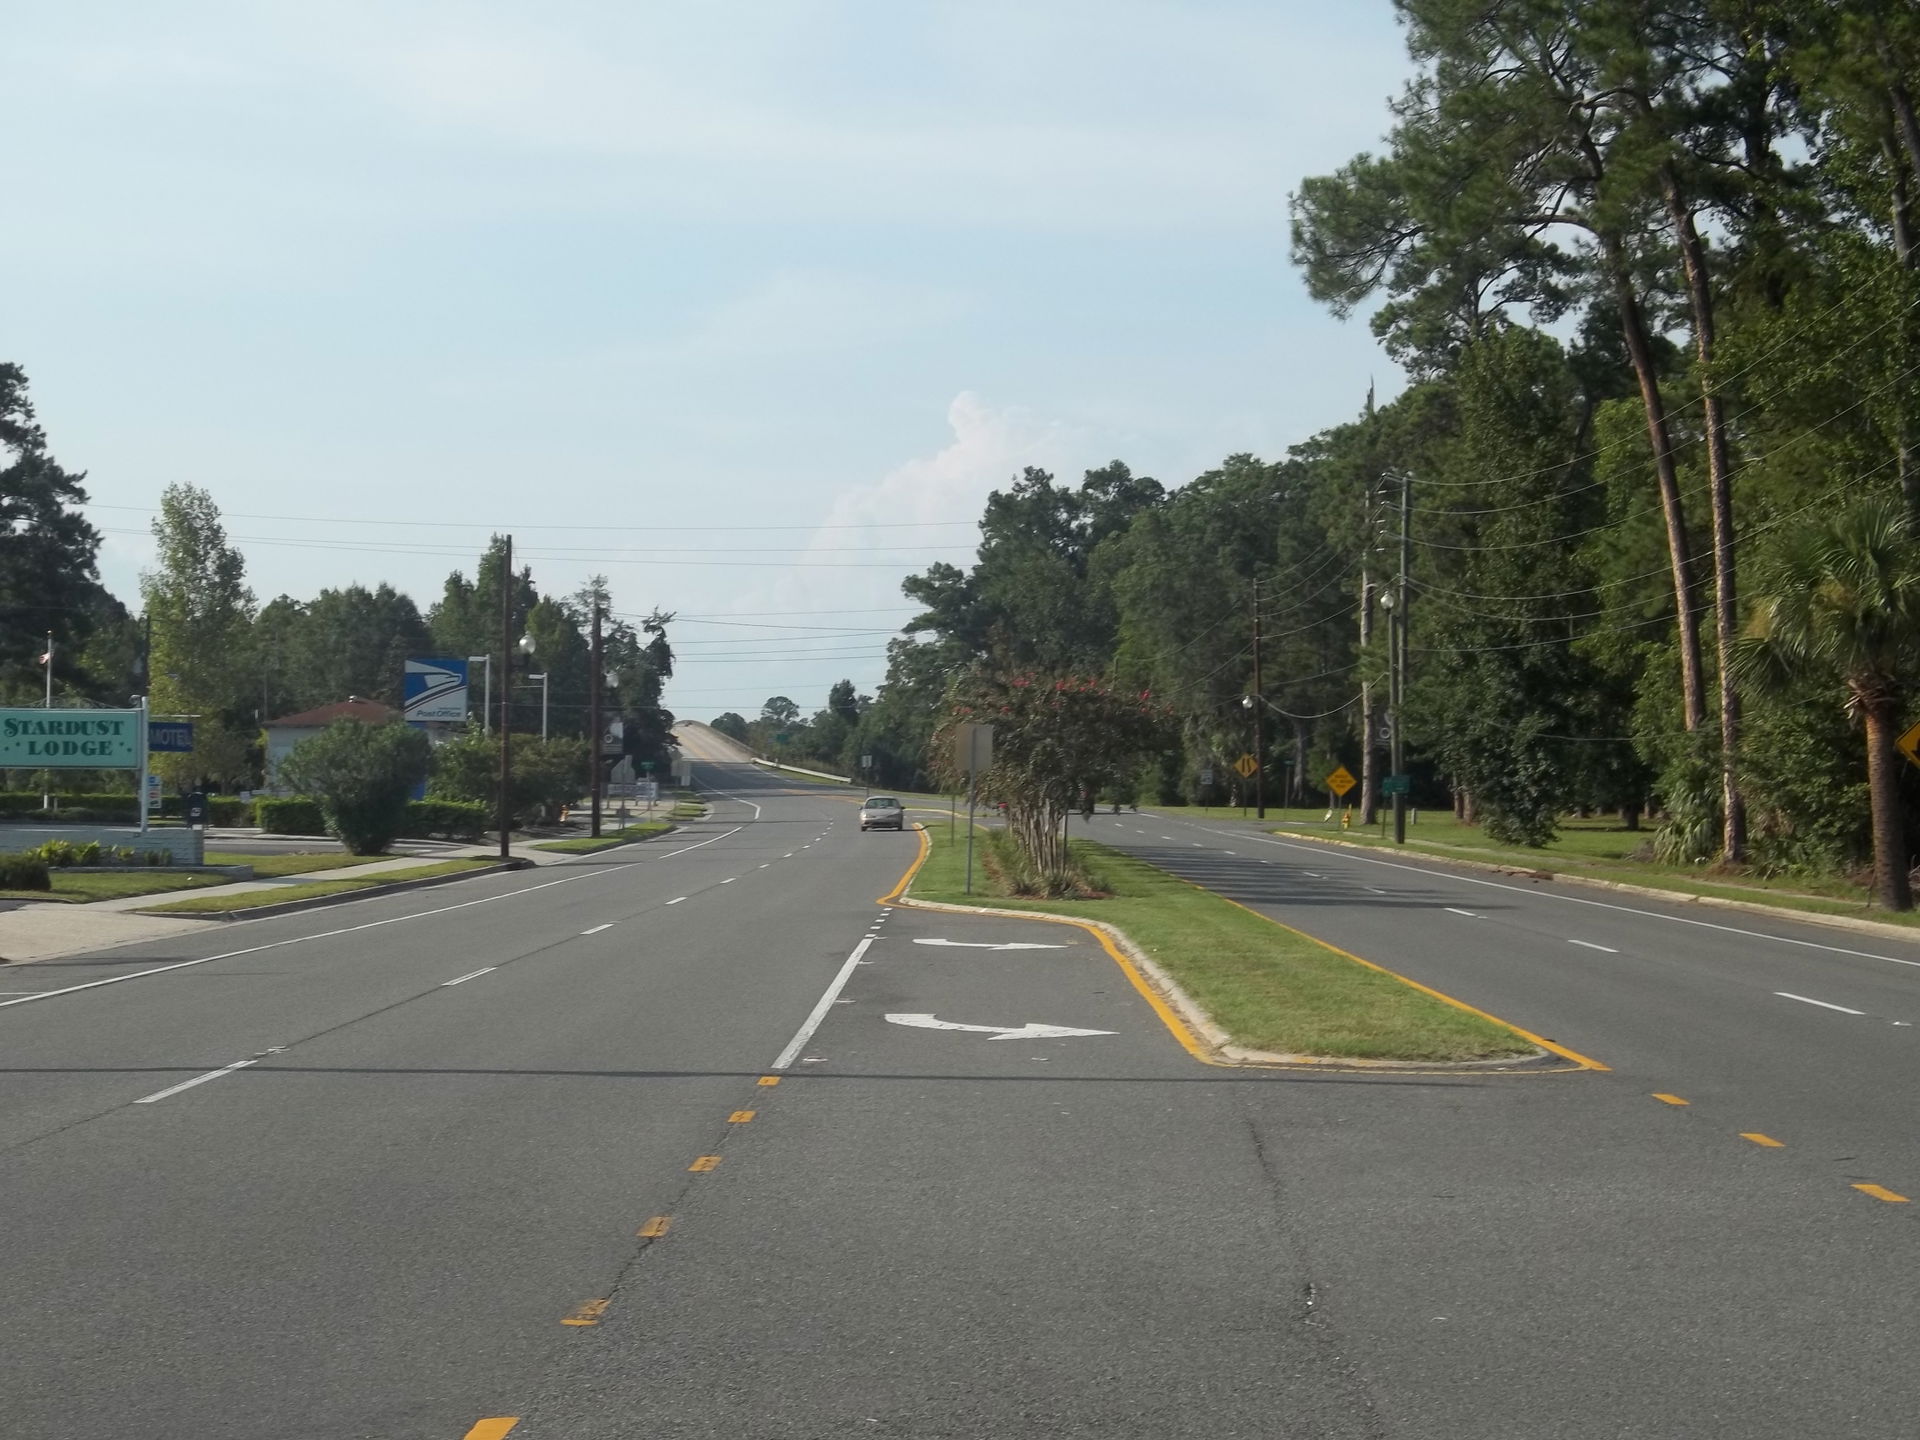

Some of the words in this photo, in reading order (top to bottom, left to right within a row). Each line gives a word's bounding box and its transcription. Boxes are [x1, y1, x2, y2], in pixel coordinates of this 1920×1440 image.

[4, 718, 125, 737] STARDUST
[149, 728, 192, 746] MOTEL
[28, 740, 113, 756] LODGE
